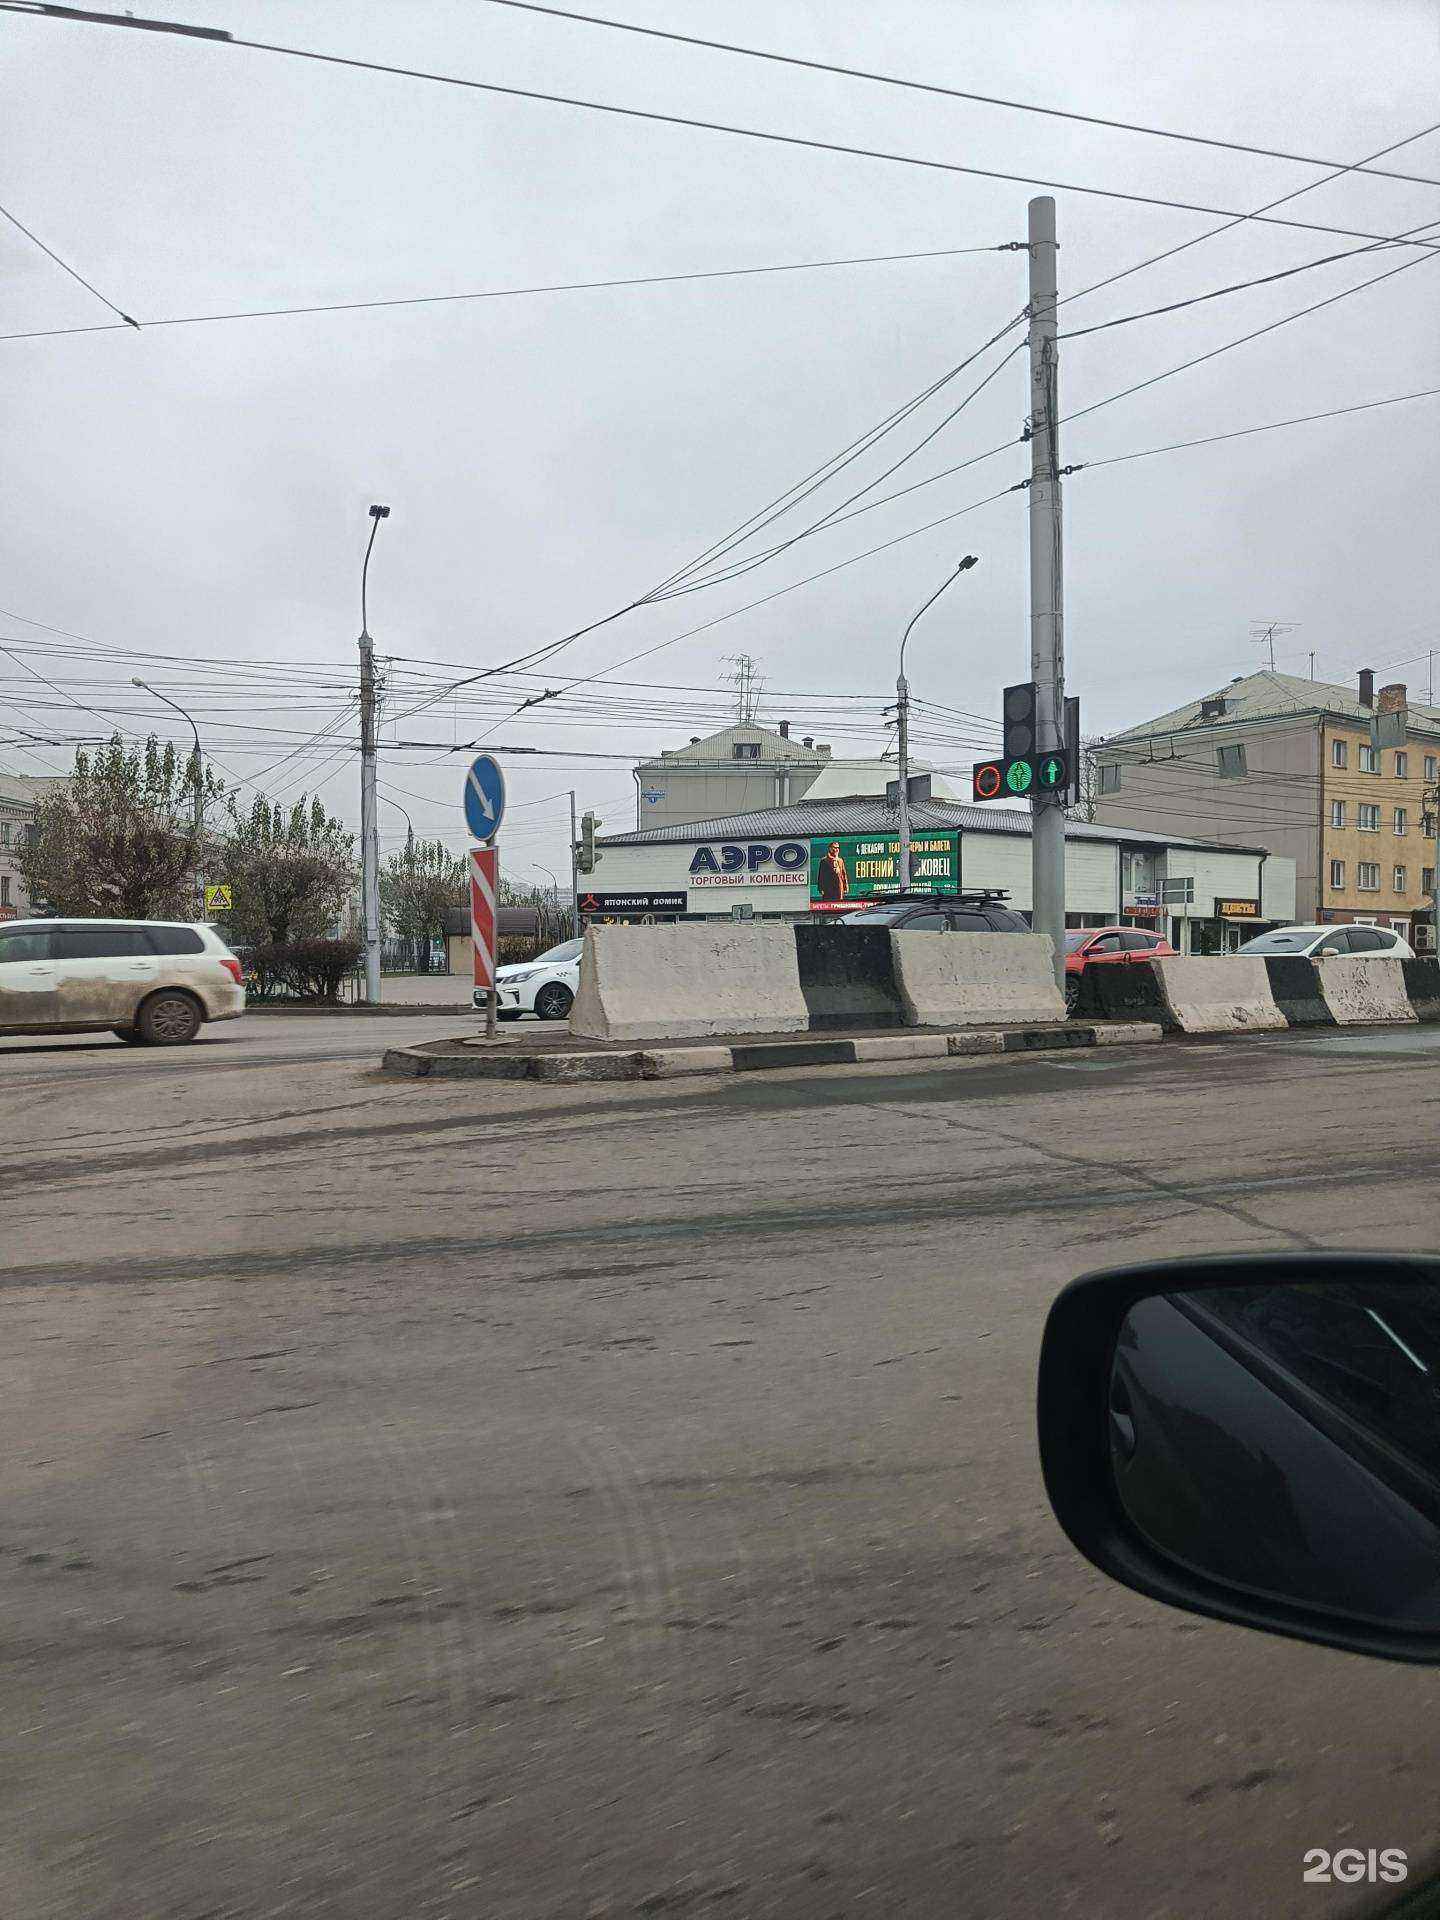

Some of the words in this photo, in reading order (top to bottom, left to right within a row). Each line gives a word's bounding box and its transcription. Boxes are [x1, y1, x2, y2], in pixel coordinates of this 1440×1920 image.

[860, 842, 885, 855] ДЕКАБРЯ
[688, 842, 809, 873] АЭРО
[856, 857, 894, 878] ЕВГЕНИЙ
[896, 857, 951, 877] ГКОВЕЦ
[690, 874, 744, 885] ТОРГОВЫЙ
[750, 873, 805, 884] КОМПЛЕКС
[604, 897, 649, 906] ЯПОНСКИЙ
